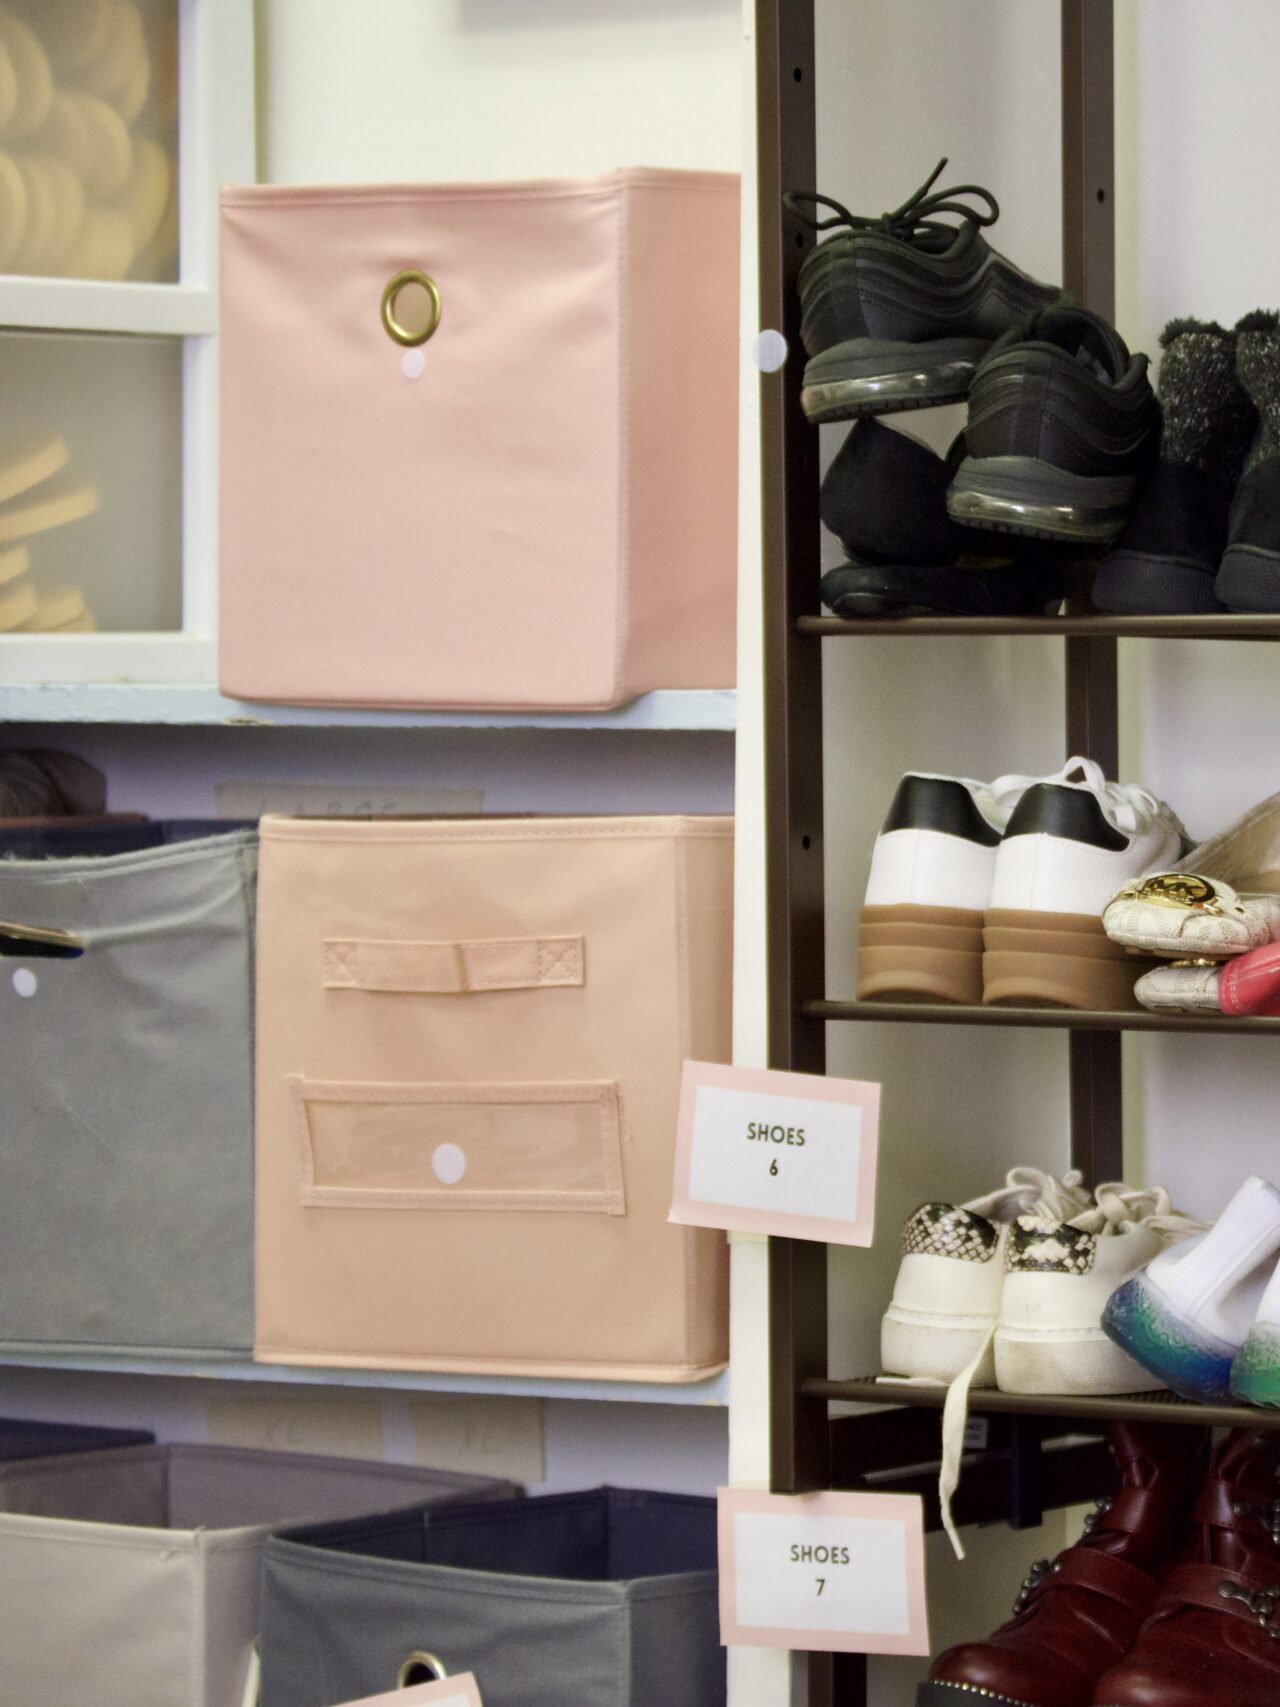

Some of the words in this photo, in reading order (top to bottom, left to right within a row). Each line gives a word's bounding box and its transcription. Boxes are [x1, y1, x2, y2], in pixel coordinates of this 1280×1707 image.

[747, 1122, 805, 1146] SHOES
[769, 1159, 778, 1176] 6
[790, 1544, 850, 1564] SHOES
[815, 1578, 826, 1596] 7
